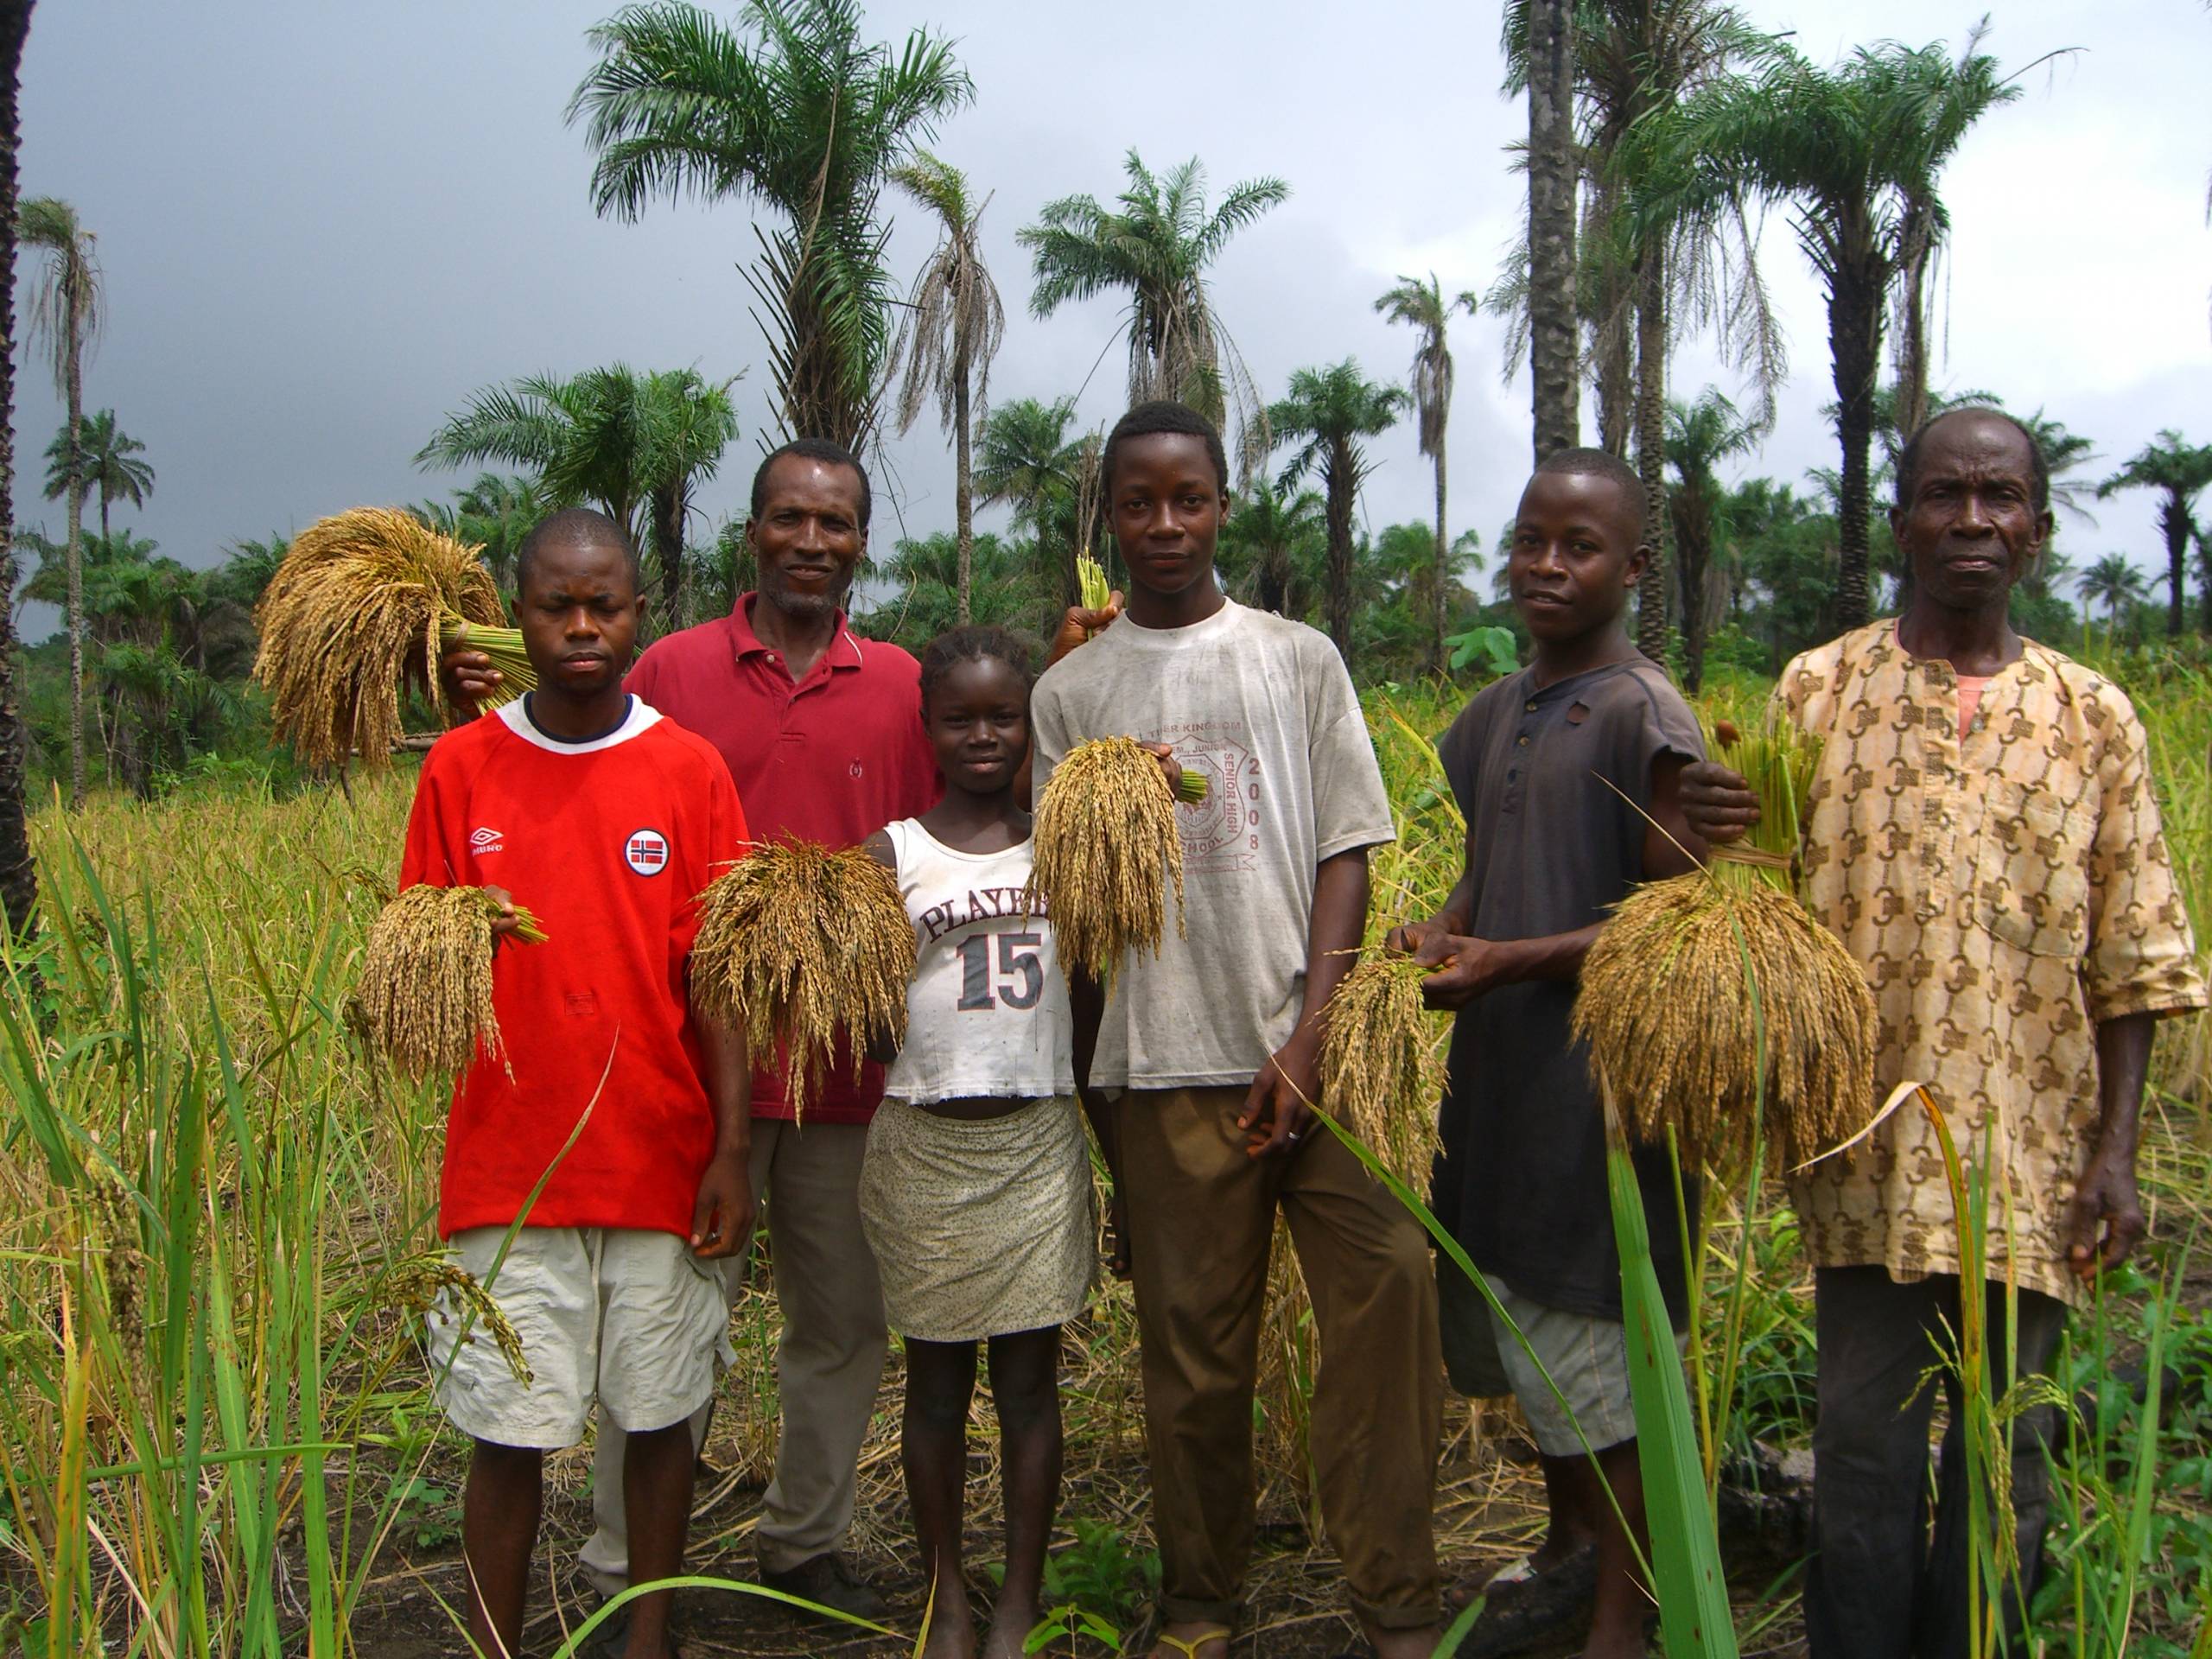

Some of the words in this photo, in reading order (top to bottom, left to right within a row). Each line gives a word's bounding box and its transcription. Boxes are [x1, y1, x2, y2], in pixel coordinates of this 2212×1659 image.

[1182, 721, 1242, 732] KINGOM
[1224, 753, 1236, 799] SENIOR
[1225, 804, 1237, 834] HIGH
[471, 842, 503, 856] MBRO
[956, 933, 1043, 1011] 15
